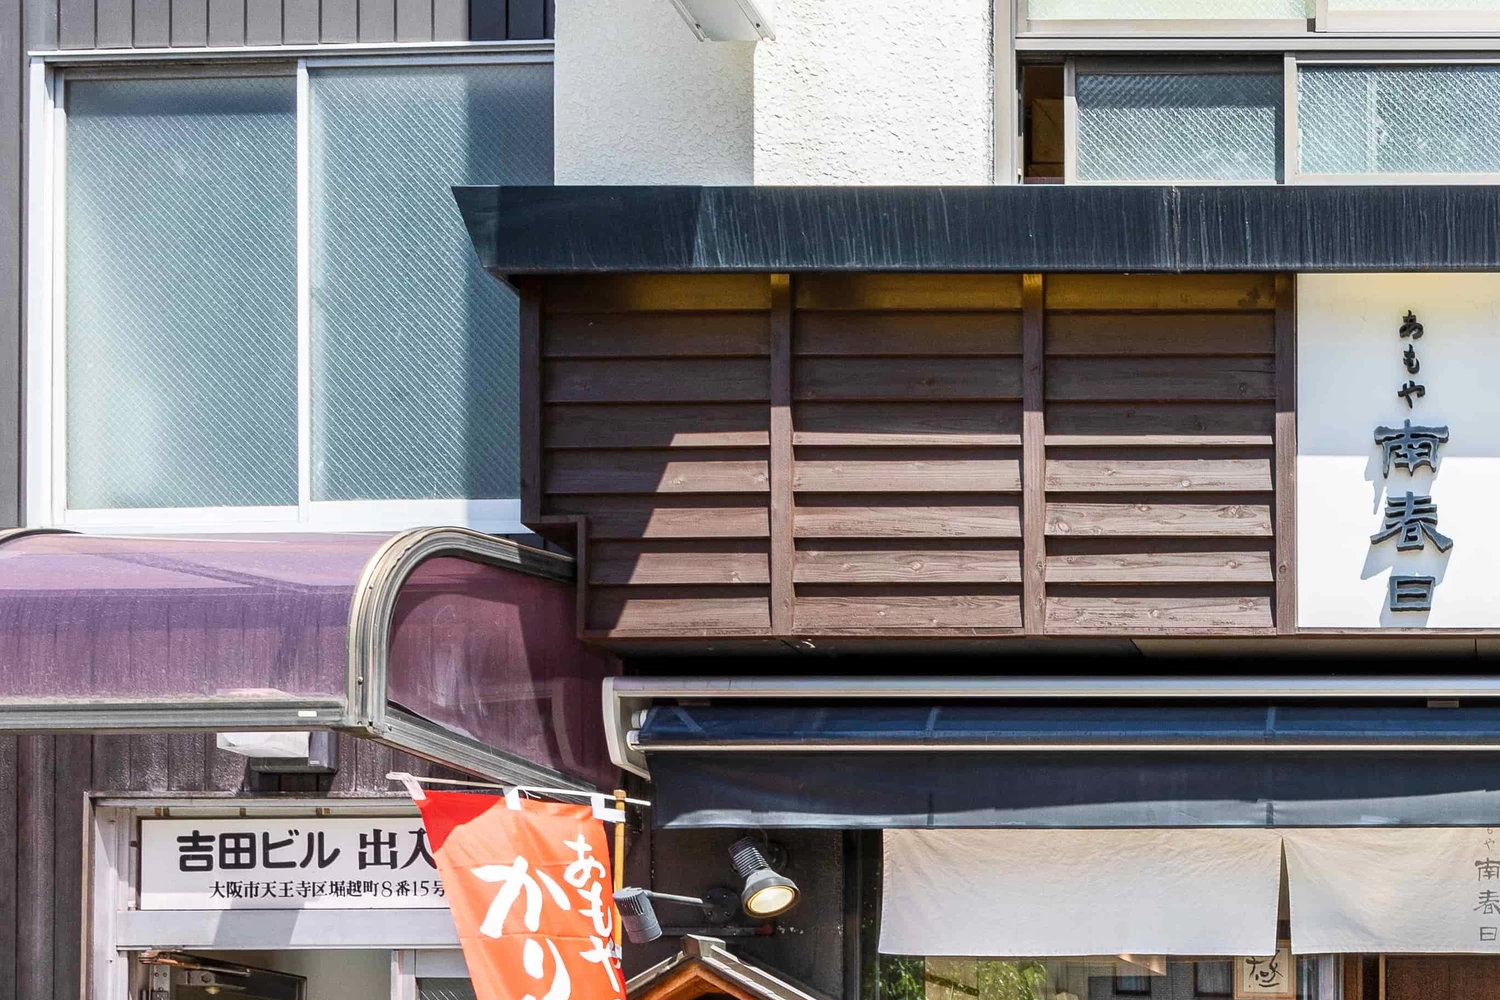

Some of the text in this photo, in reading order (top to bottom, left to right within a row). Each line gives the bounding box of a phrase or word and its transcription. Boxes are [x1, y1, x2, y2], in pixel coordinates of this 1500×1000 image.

[1370, 310, 1453, 612] あもや 南春日
[177, 829, 340, 872] 吉田ビル
